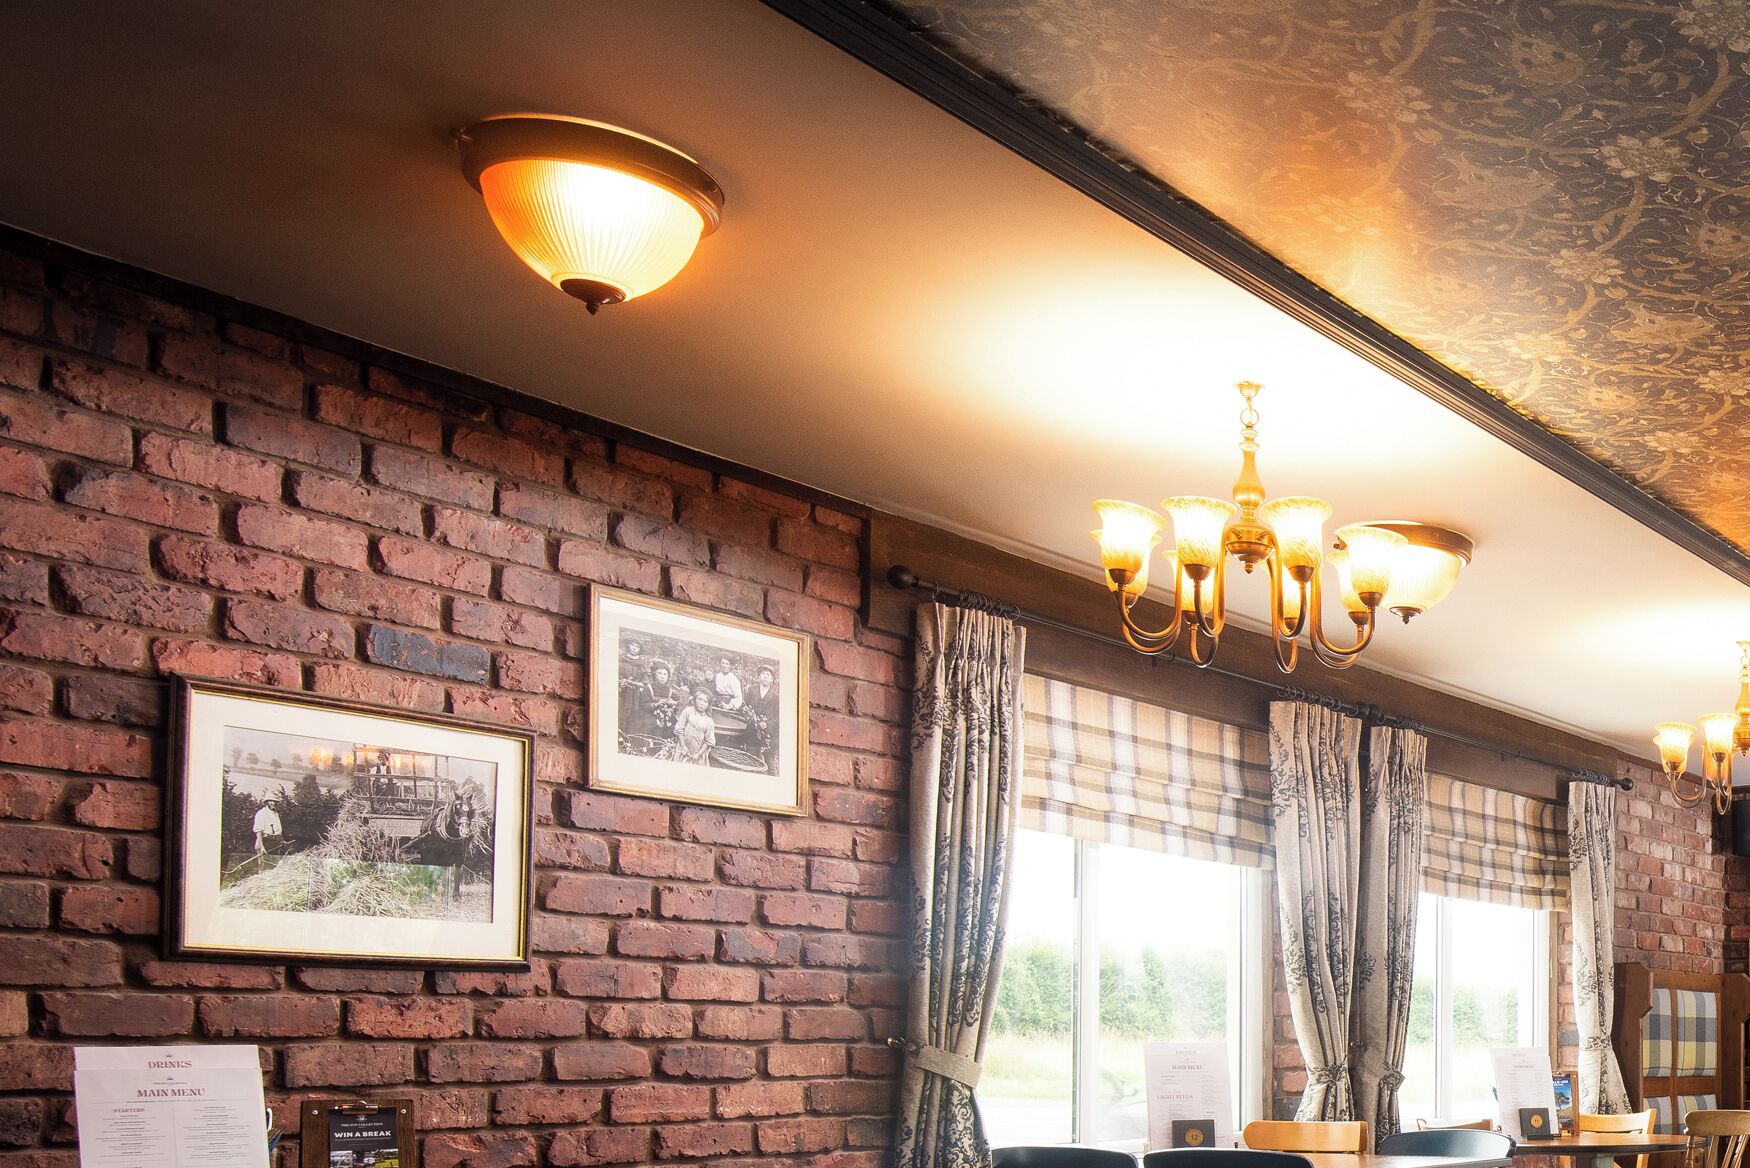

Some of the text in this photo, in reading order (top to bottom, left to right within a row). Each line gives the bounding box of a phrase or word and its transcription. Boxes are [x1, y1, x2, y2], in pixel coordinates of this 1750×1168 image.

[148, 1060, 193, 1069] DRINKS
[137, 1088, 205, 1098] MAIN MENU
